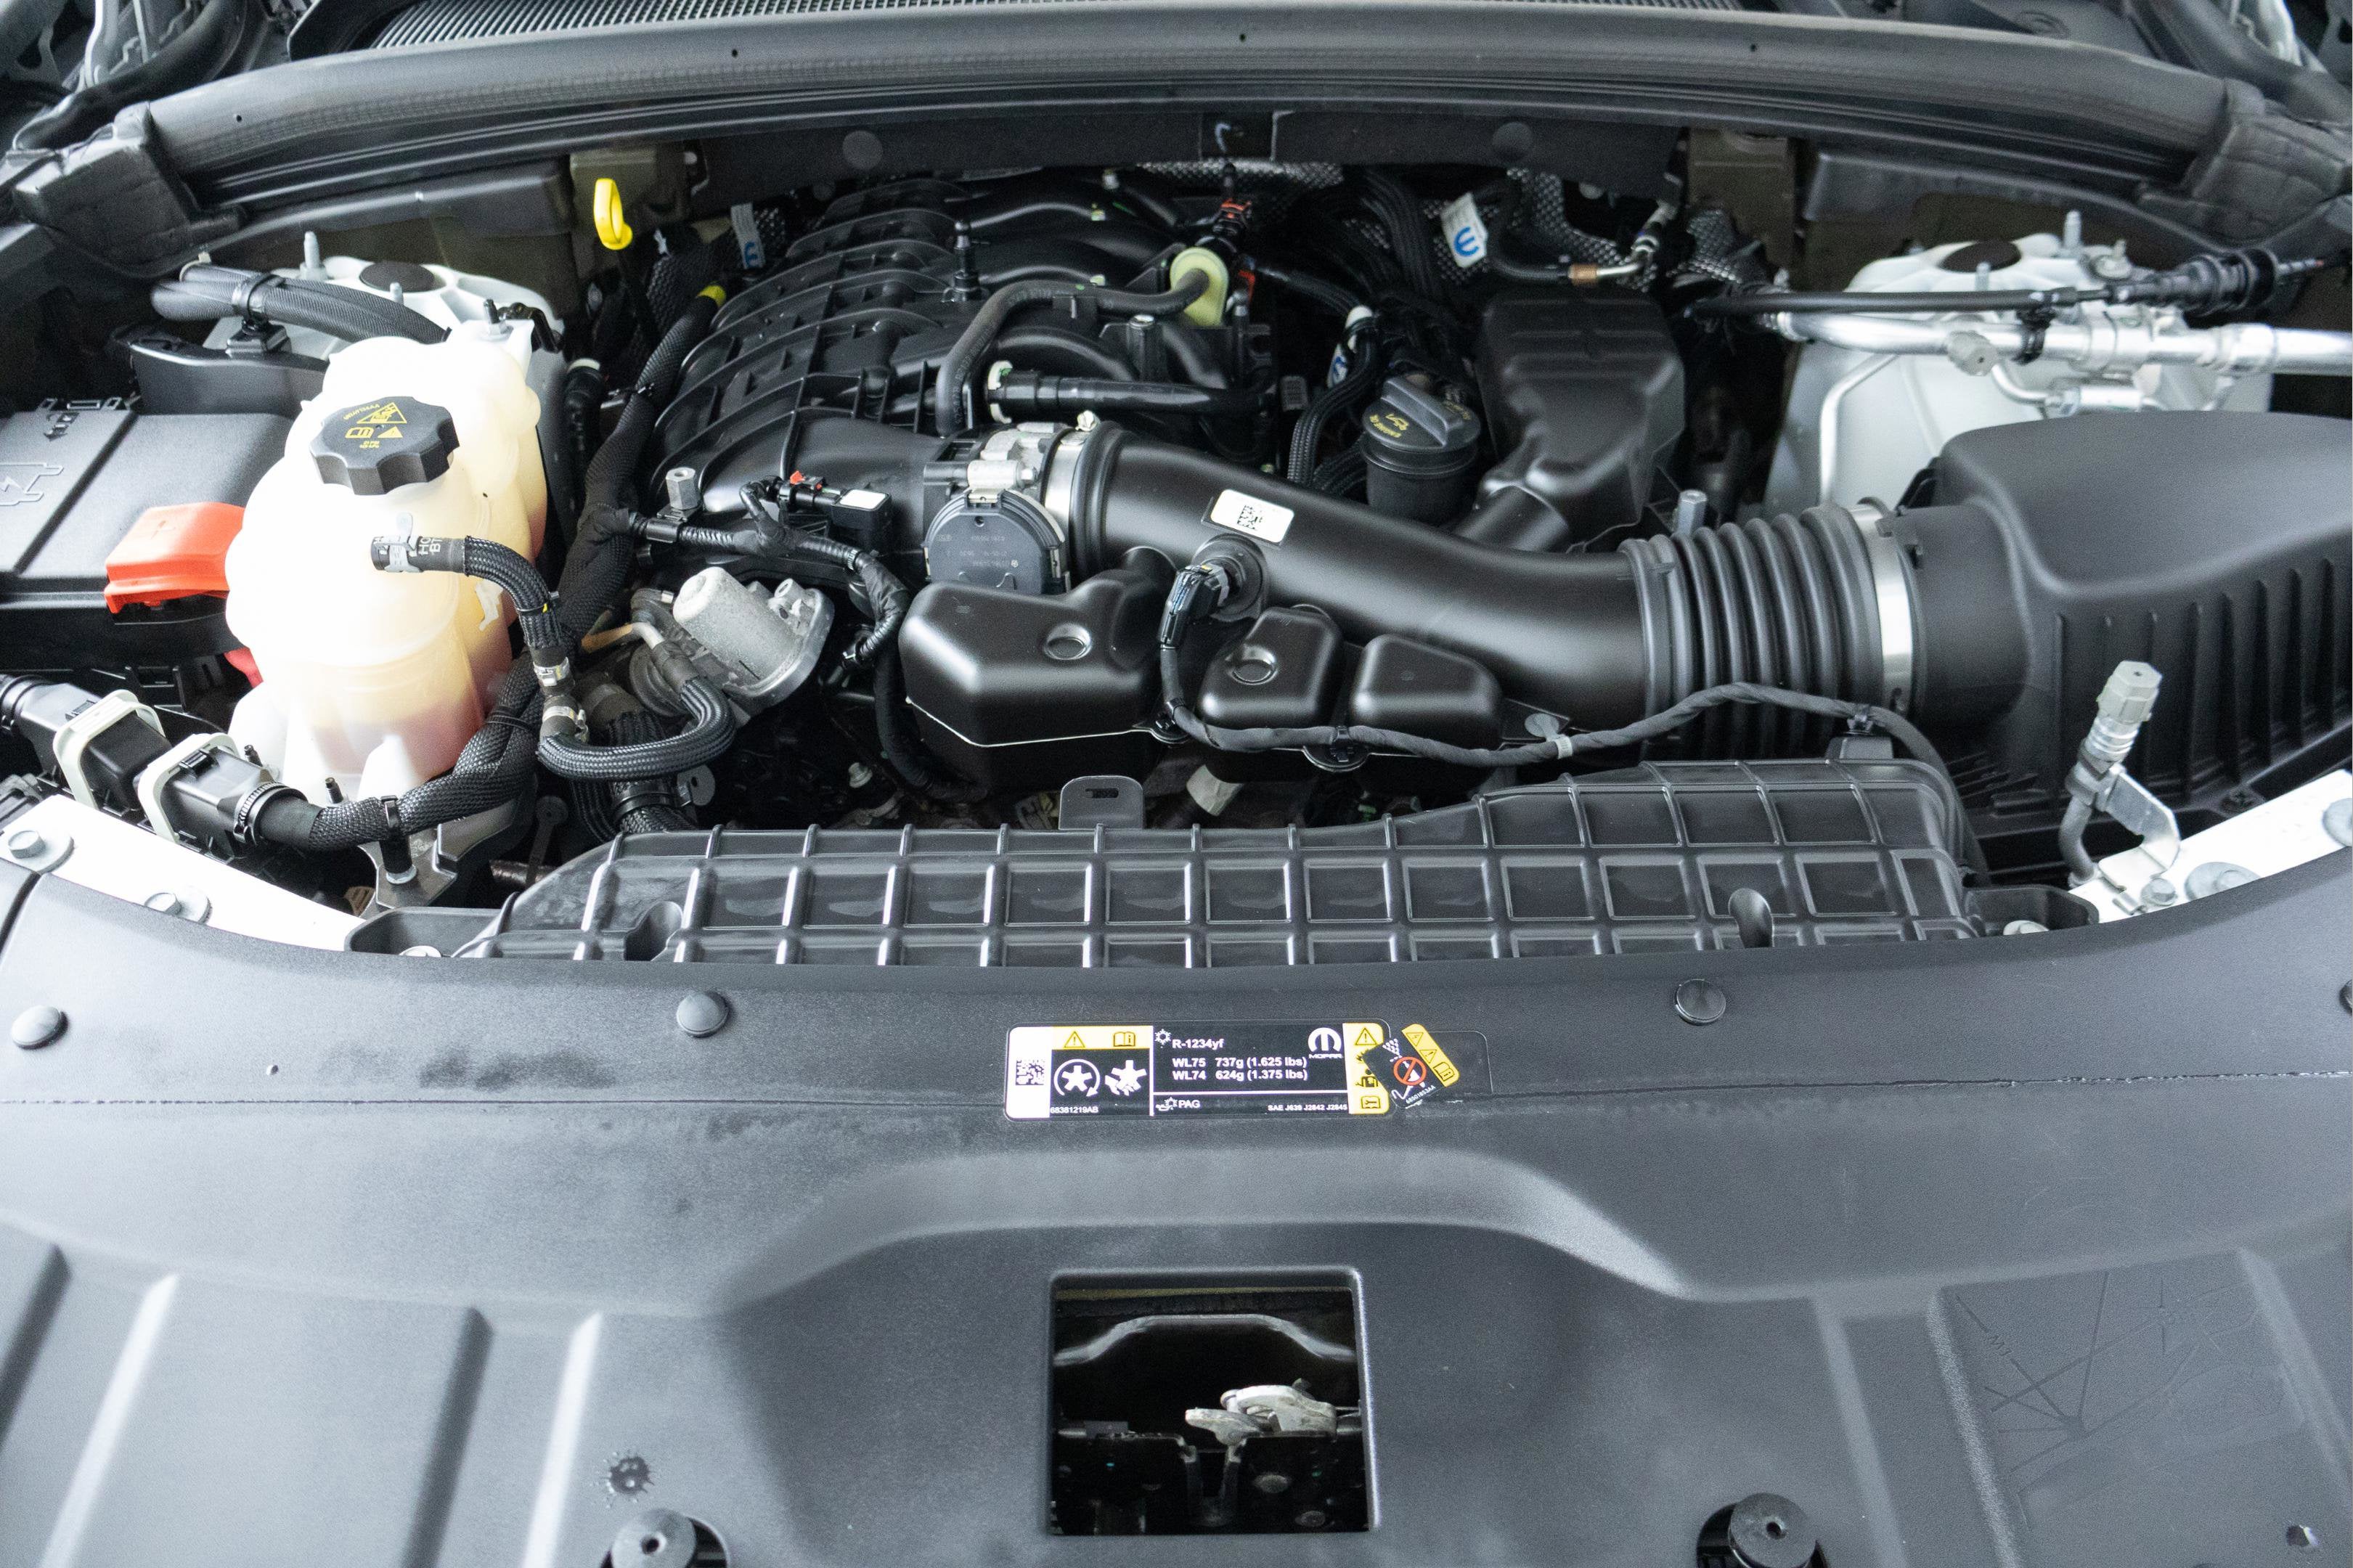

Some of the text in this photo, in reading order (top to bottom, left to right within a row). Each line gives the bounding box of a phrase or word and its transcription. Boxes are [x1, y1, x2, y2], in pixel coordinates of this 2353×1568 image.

[1172, 1038, 1224, 1050] R-1234yf
[1172, 1057, 1307, 1069] WL75 737g (1.625 lbs)
[1172, 1069, 1308, 1082] WL74 624g (1.375 lbs)
[1178, 1099, 1201, 1108] PAG
